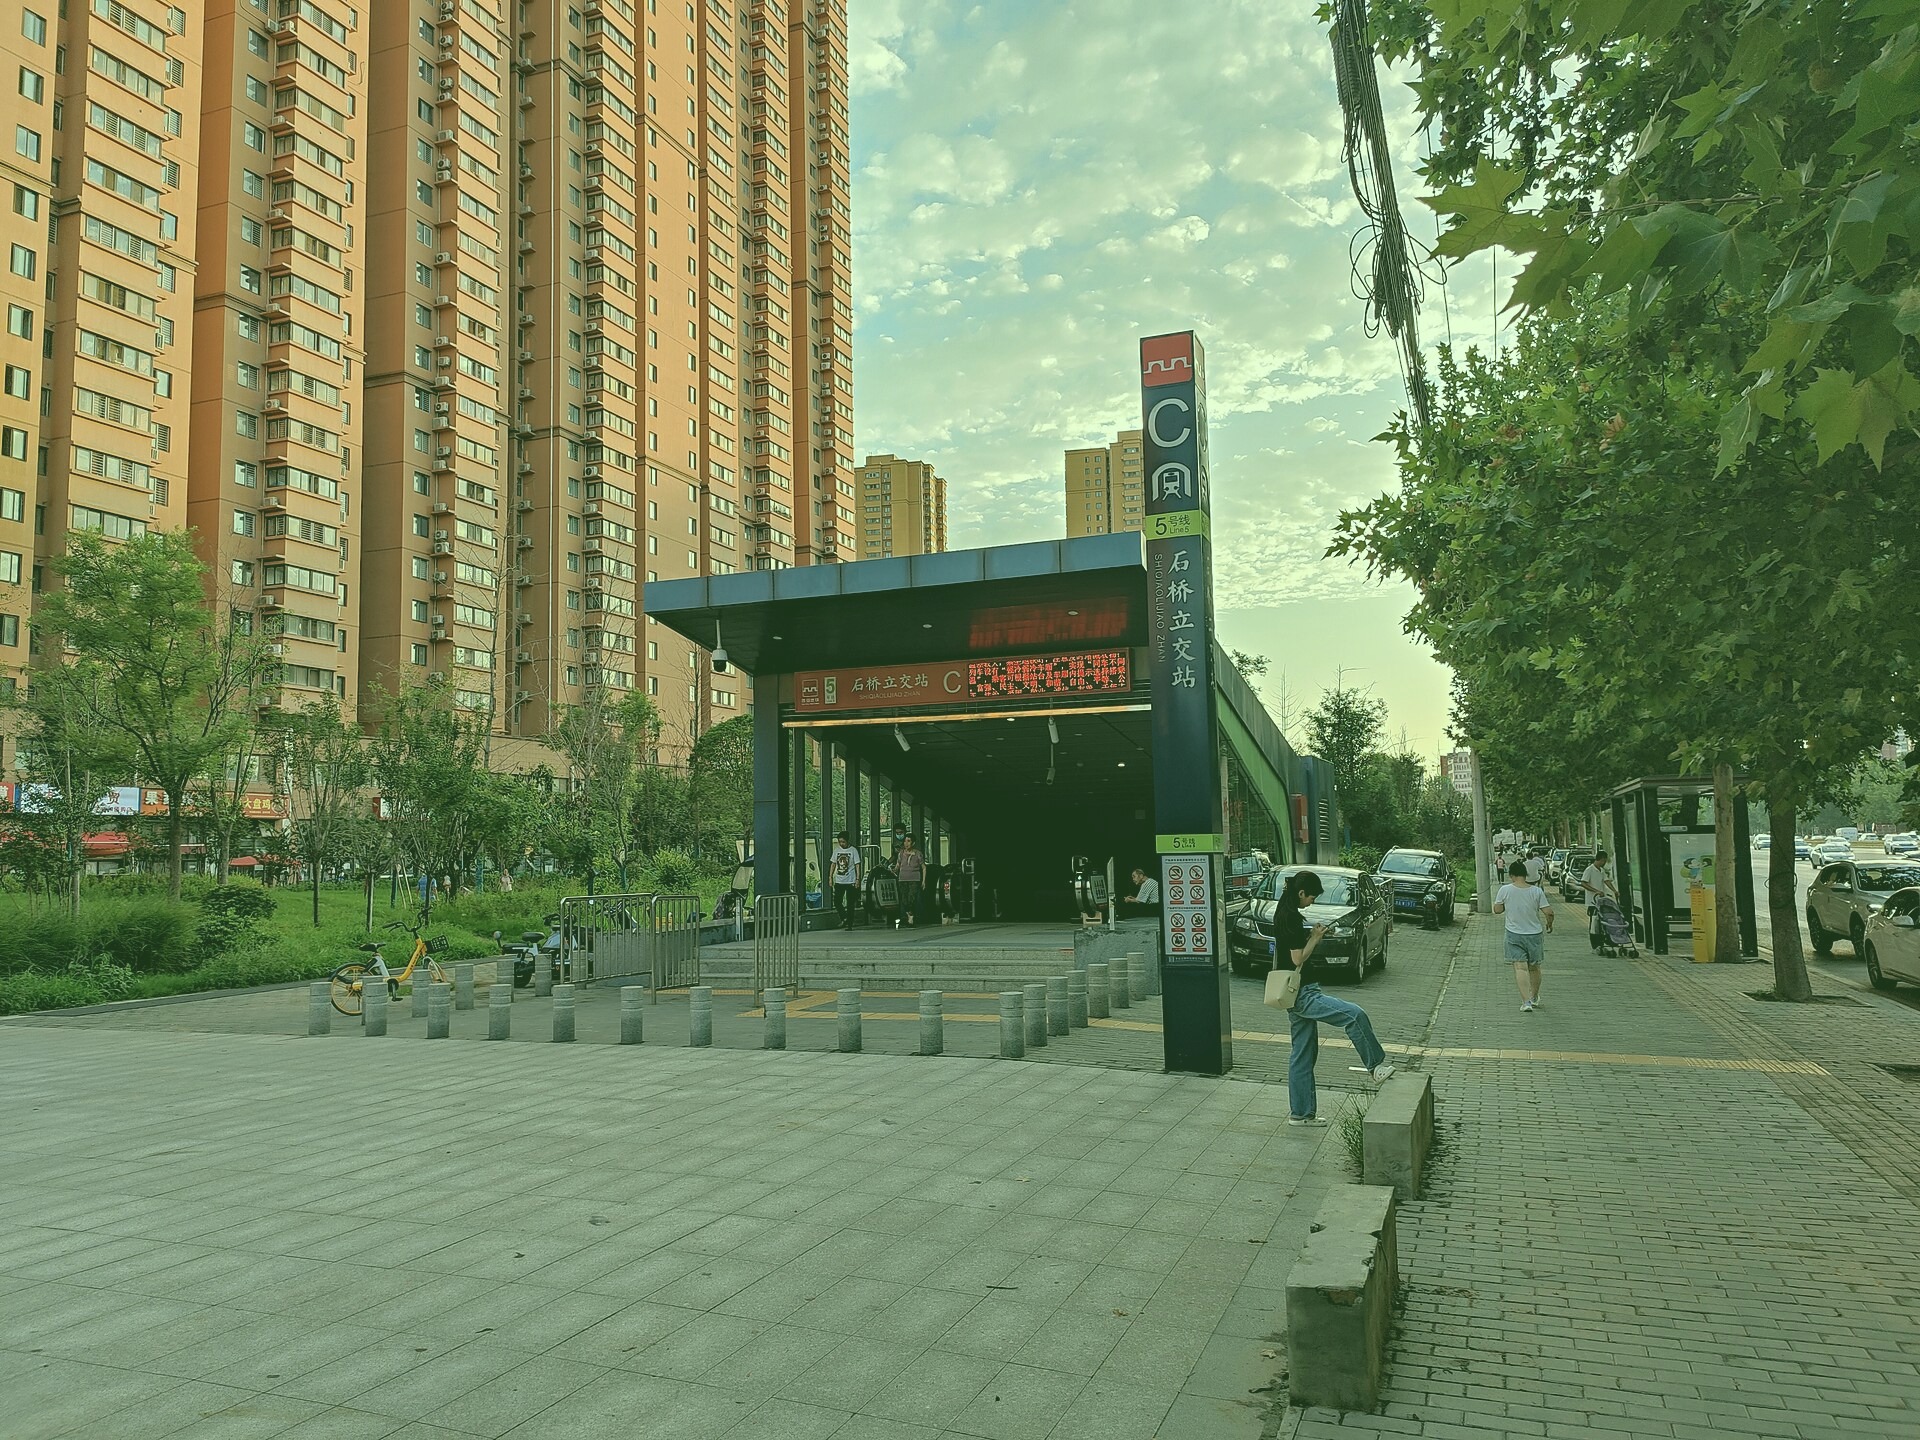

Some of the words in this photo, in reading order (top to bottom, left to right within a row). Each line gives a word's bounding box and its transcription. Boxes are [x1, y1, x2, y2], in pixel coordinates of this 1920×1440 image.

[1147, 397, 1191, 449] C
[1166, 550, 1196, 688] 石桥立交站
[1156, 635, 1166, 663] ZHAN
[851, 673, 929, 693] 石桥立交站
[943, 671, 962, 694] C
